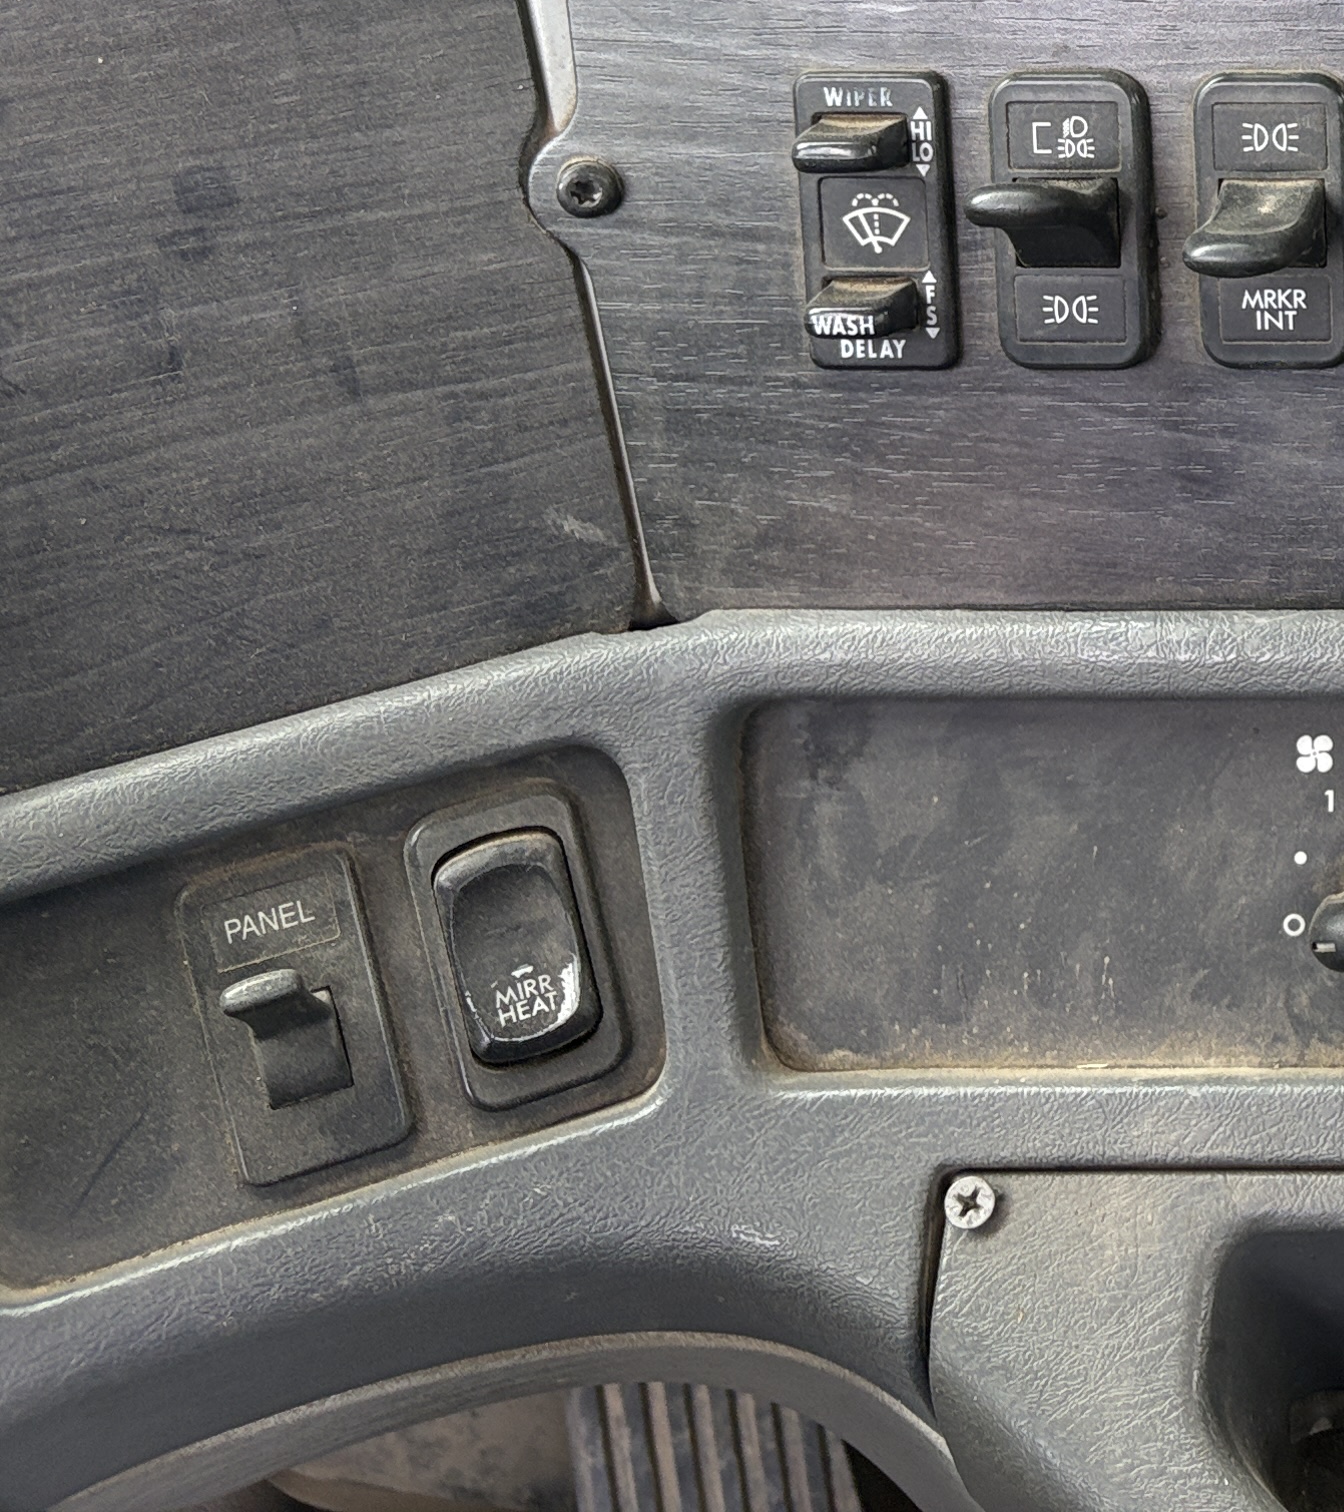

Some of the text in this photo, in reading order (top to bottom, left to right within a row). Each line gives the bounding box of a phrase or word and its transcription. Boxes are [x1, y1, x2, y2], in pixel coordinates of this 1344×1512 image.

[910, 121, 932, 141] HI
[911, 143, 933, 163] LO
[926, 285, 936, 303] F
[1241, 288, 1307, 309] MRKR
[811, 315, 875, 336] WASH
[926, 306, 938, 326] S
[1256, 310, 1297, 330] INT
[841, 339, 906, 359] DELAY
[1324, 789, 1335, 813] 1
[224, 899, 315, 944] PANEL
[494, 974, 554, 1009] MIRR
[498, 990, 558, 1028] HEAT
